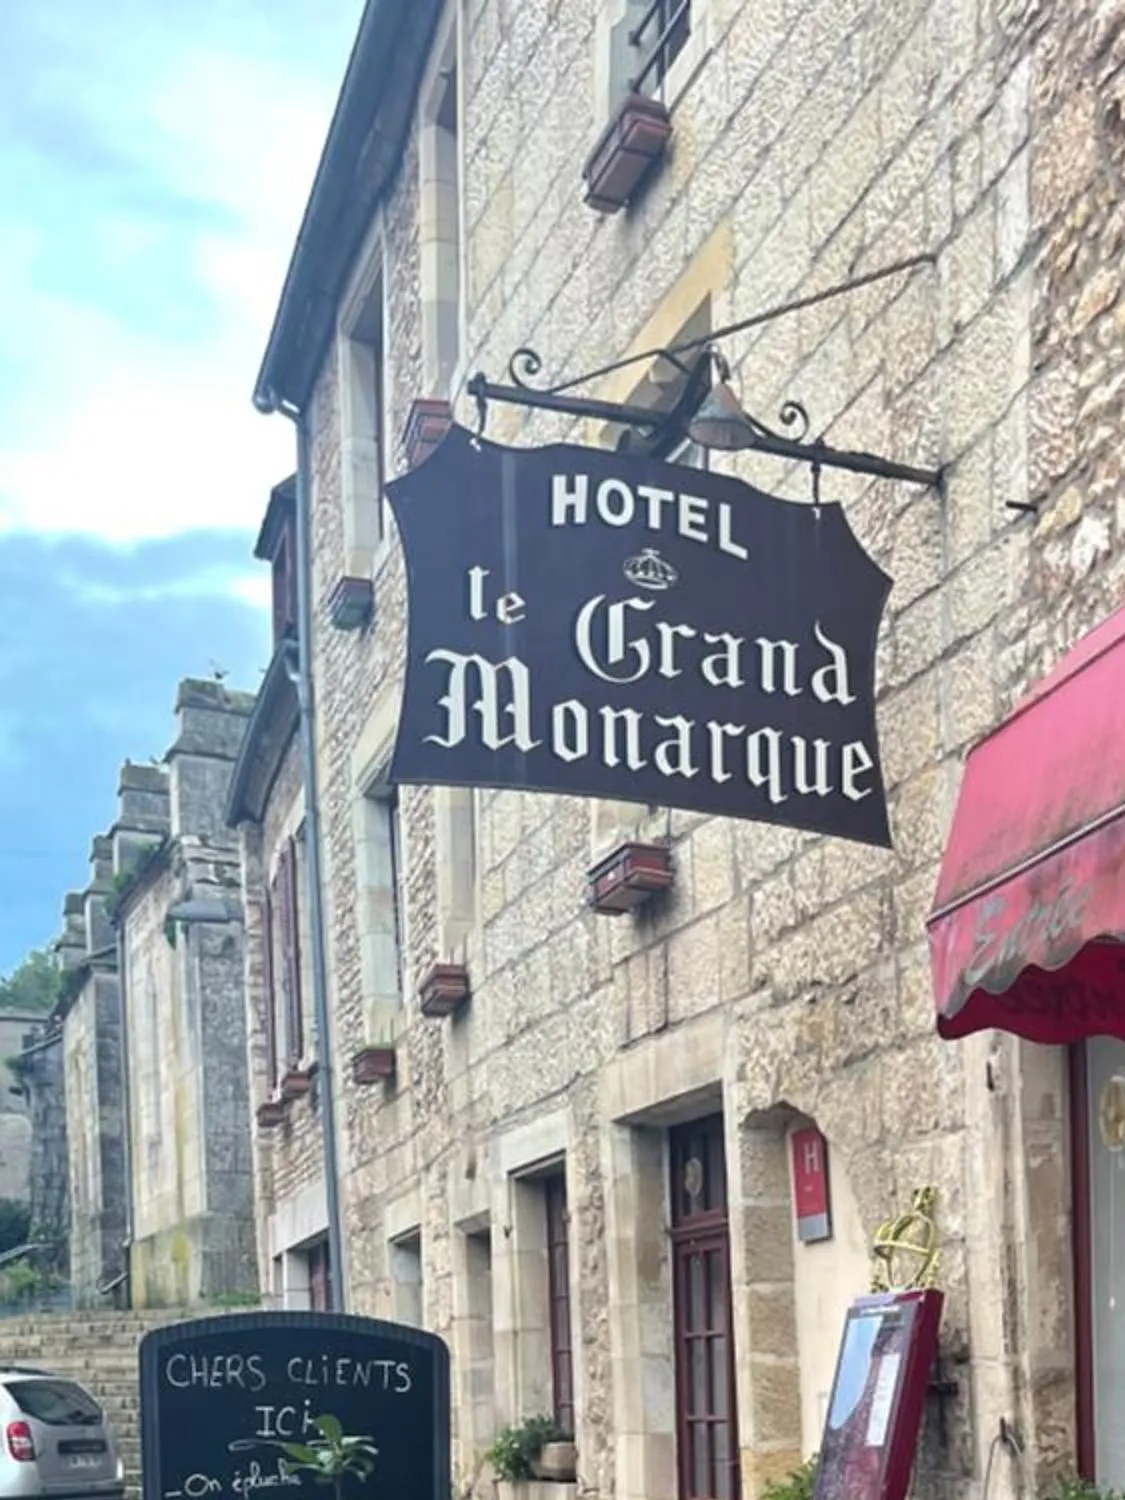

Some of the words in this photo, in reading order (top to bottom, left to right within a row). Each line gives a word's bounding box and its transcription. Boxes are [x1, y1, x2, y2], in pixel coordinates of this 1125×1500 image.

[552, 474, 748, 560] HOTEL
[575, 594, 857, 706] Grand
[421, 648, 874, 804] Monarque
[166, 1354, 267, 1392] CHERS
